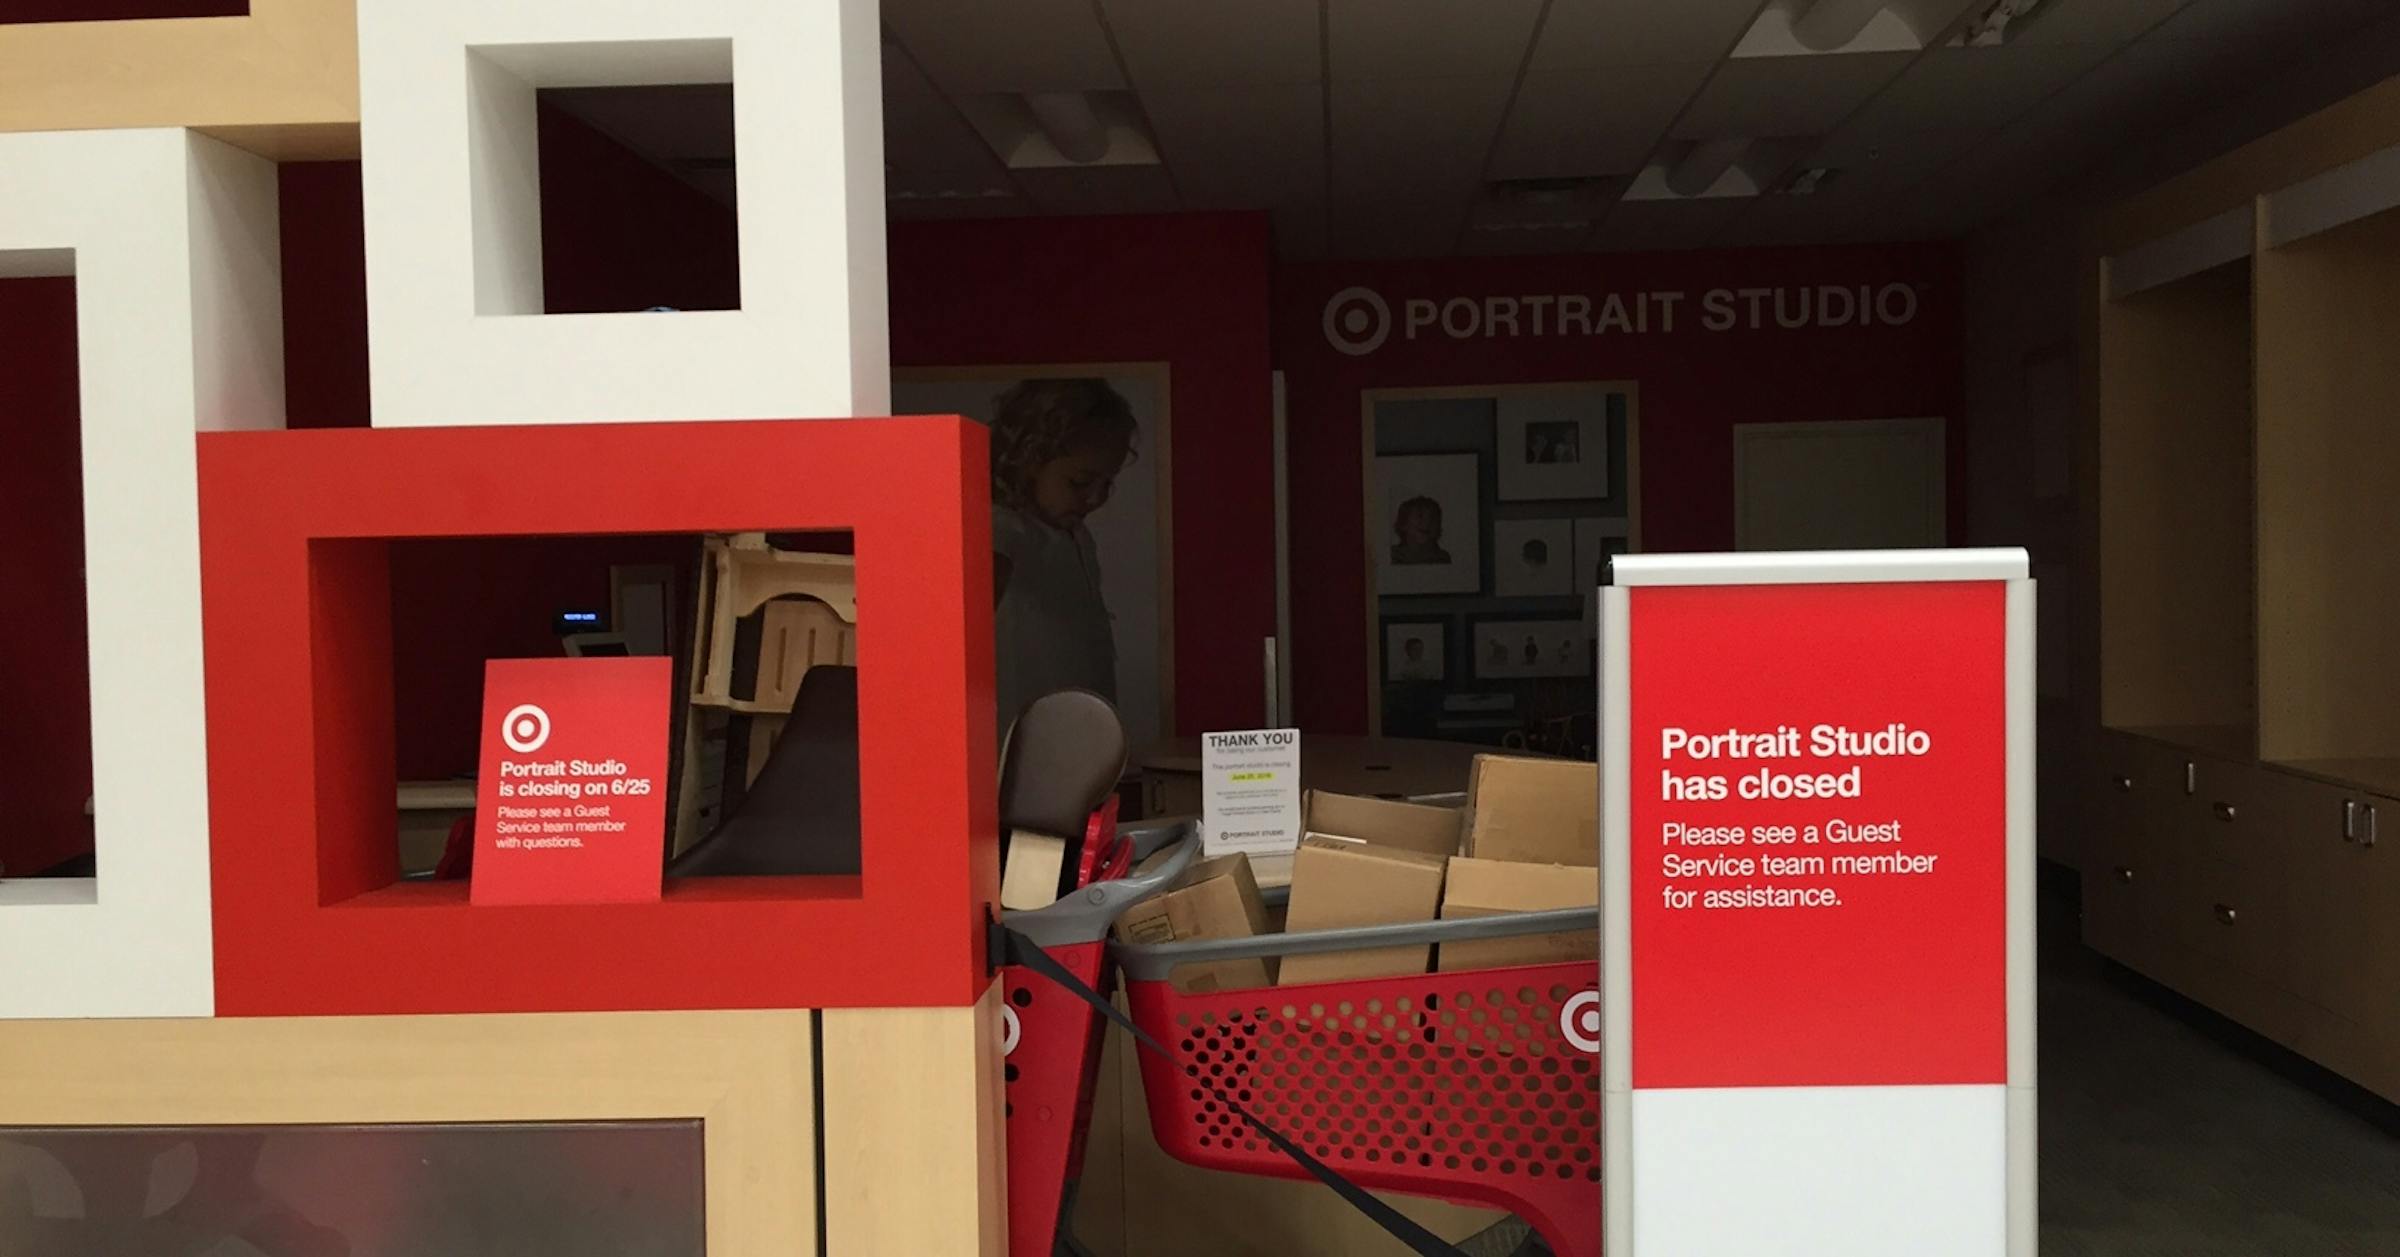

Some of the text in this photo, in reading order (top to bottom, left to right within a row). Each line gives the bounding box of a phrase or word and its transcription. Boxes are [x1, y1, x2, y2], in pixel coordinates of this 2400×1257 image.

[1405, 282, 1918, 340] PORTRAIT STUDIO
[1208, 732, 1293, 747] THANK YOU
[1662, 722, 1931, 760] Portrait Studio
[501, 760, 627, 777] Portrait Studio
[499, 779, 651, 799] is closing on 6/25
[1662, 765, 1861, 801] has closed
[497, 805, 610, 818] Please see a Guest
[496, 820, 626, 833] Service team member
[1662, 818, 1902, 846] Please see a Guest
[496, 836, 583, 850] with questions.
[1662, 850, 1938, 878] Service team member
[1662, 884, 1842, 909] for assistance.
